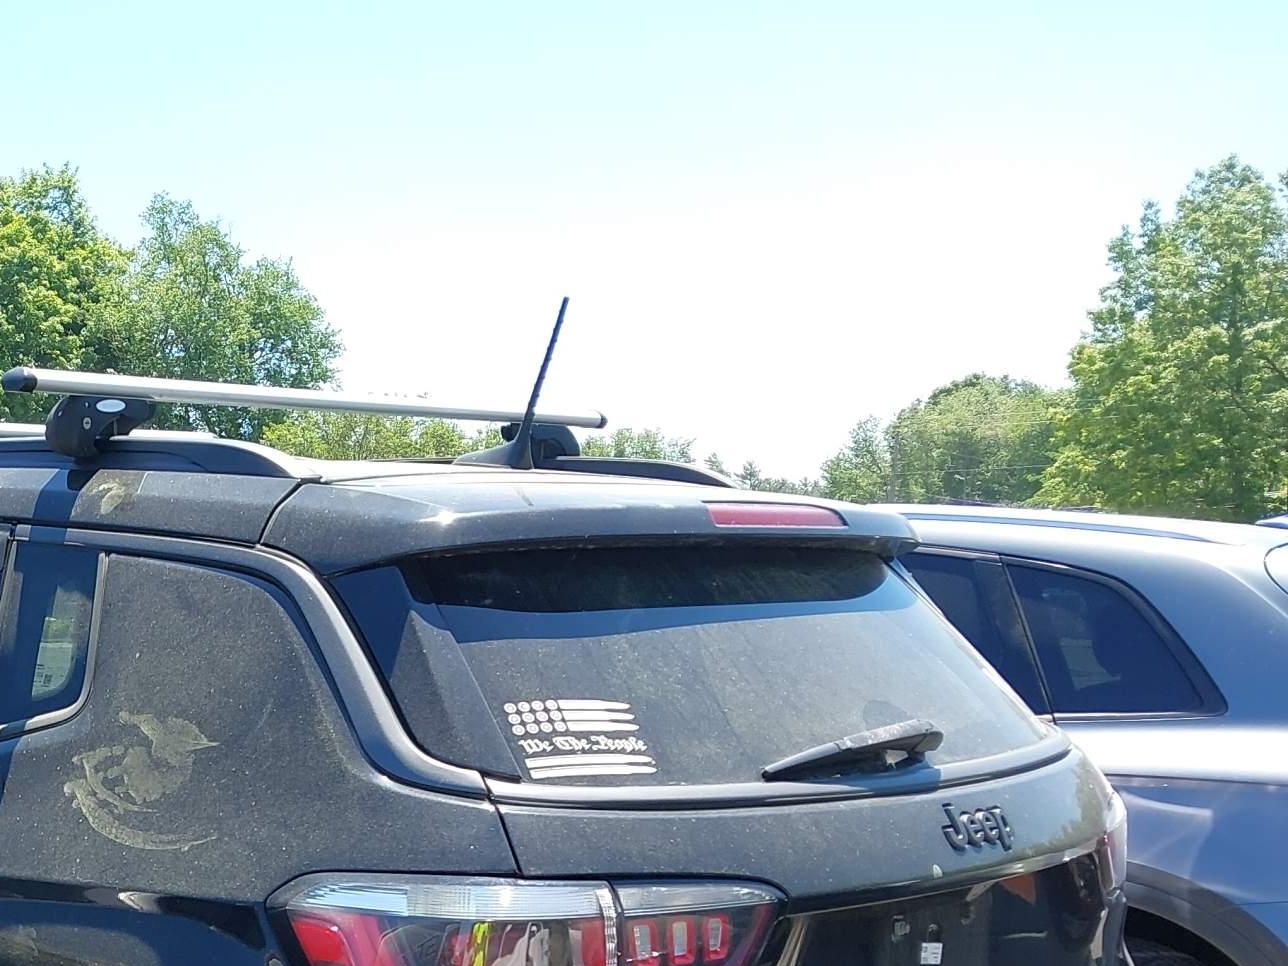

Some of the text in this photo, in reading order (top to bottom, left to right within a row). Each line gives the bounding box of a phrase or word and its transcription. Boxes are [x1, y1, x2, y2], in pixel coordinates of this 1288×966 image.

[518, 734, 648, 754] We The People
[941, 802, 1015, 853] Jeep
